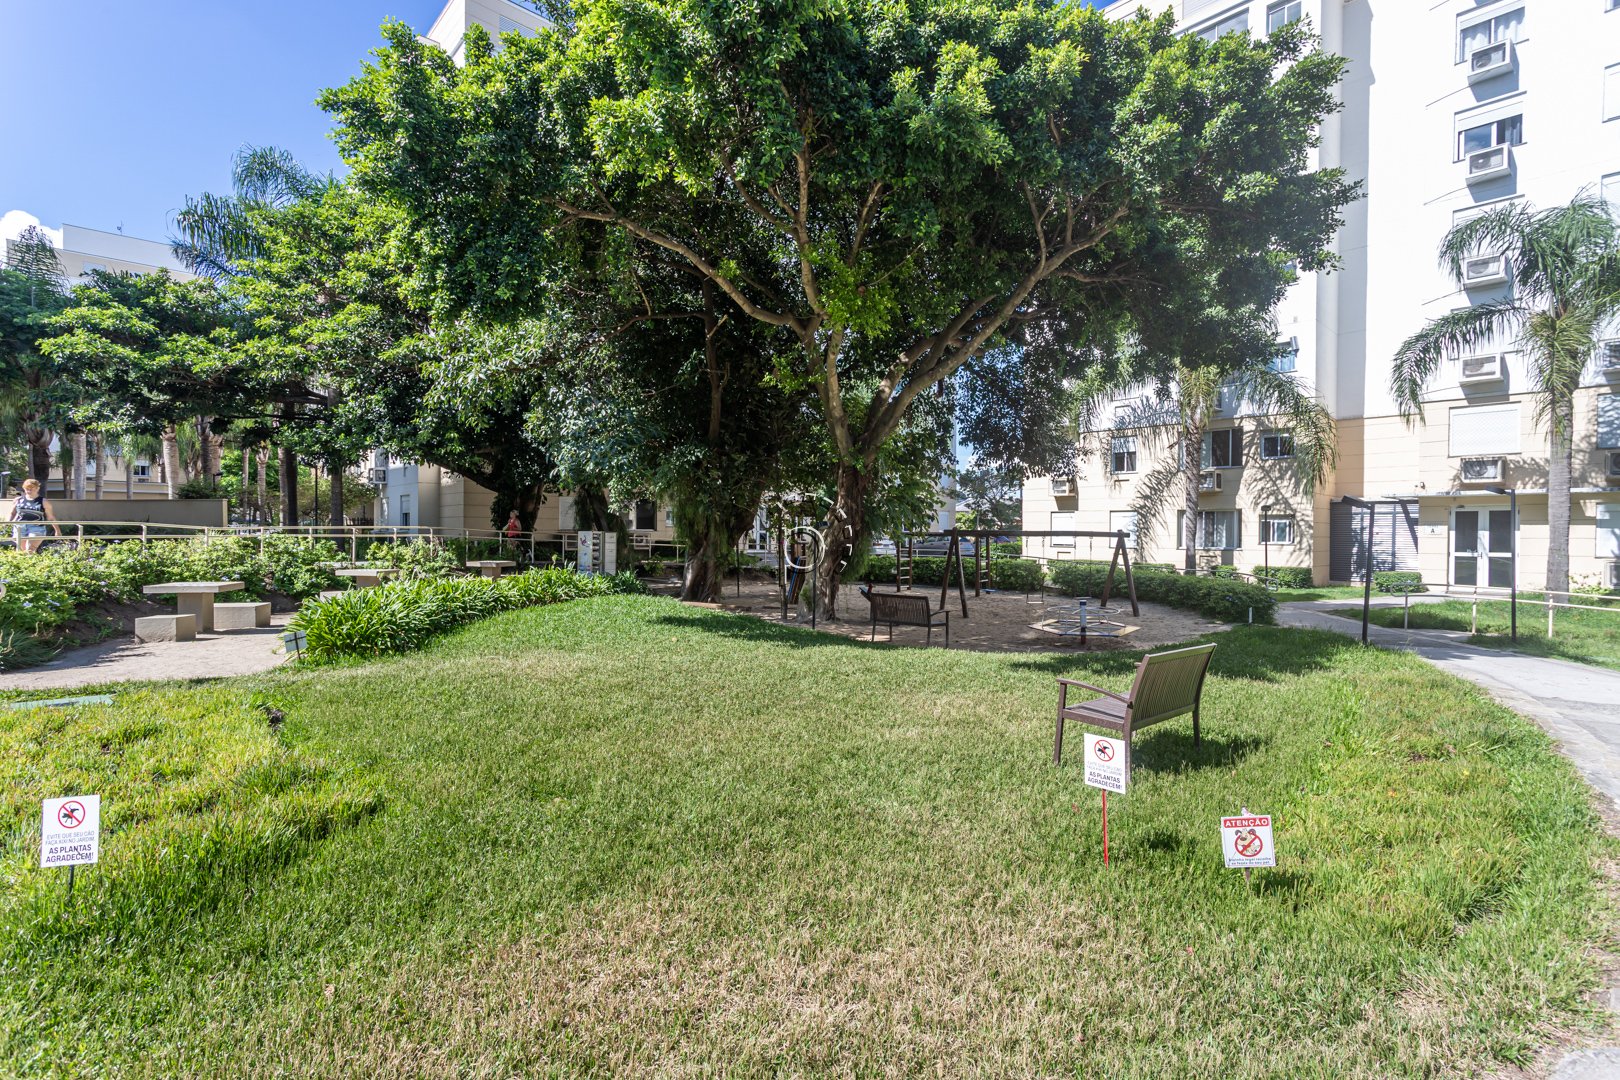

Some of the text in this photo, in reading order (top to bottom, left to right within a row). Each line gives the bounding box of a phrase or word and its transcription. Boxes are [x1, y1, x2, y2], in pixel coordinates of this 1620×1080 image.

[1097, 773, 1120, 783] PLANTAS
[1225, 818, 1268, 827] ATENÇÃO
[60, 844, 91, 853] PLANTAS
[46, 853, 93, 863] AGRADECEM!
